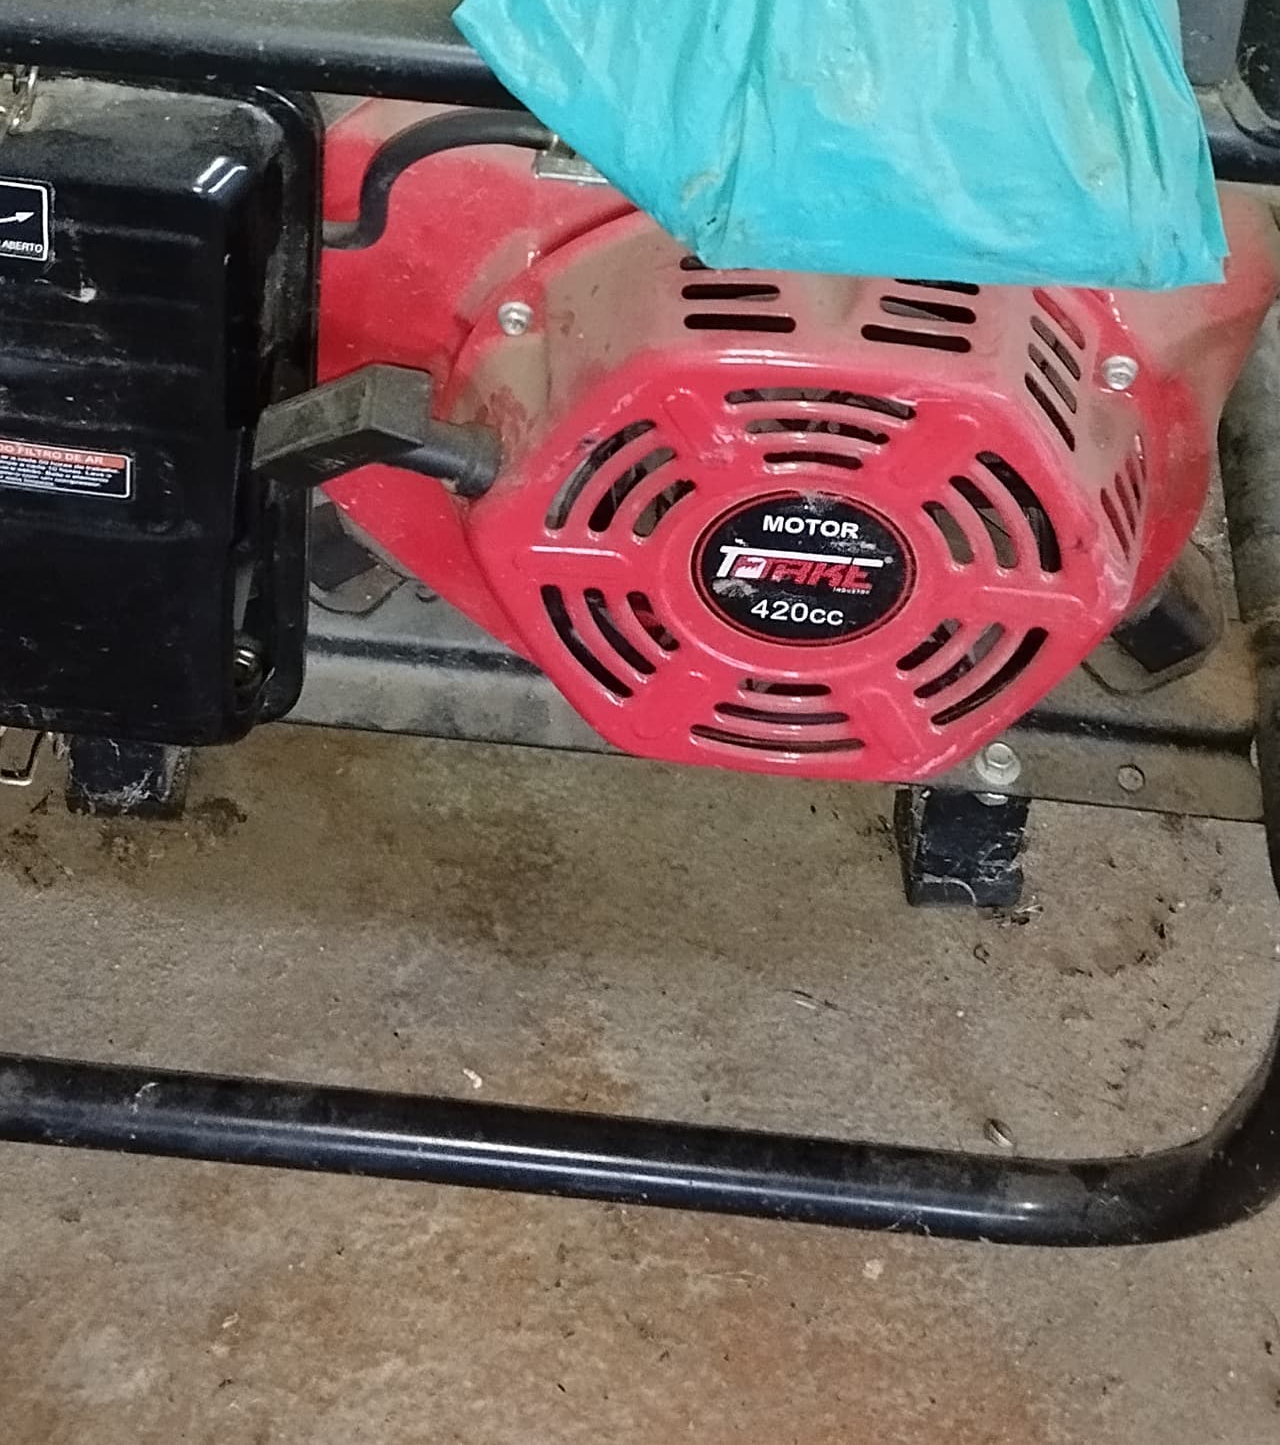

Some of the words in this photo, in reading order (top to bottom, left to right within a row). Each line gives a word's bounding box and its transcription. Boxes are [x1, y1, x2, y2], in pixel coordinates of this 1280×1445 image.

[1, 239, 44, 254] ABERTO
[85, 455, 104, 466] AR
[762, 515, 859, 540] MOTOR
[750, 599, 844, 627] 420cc
